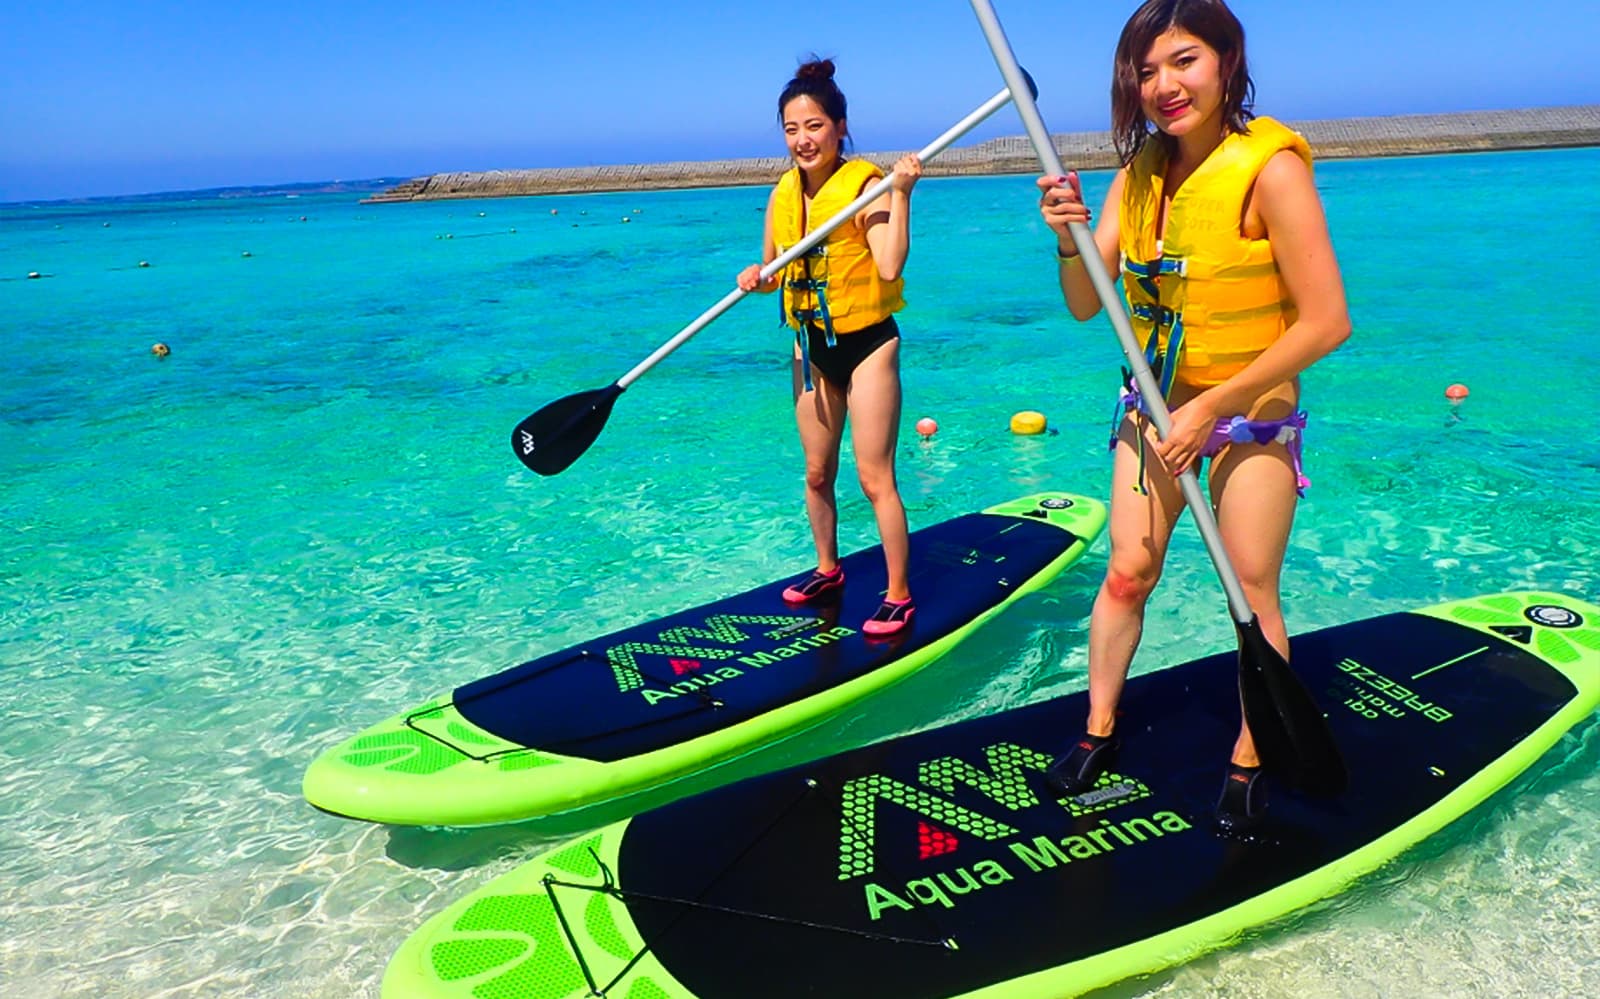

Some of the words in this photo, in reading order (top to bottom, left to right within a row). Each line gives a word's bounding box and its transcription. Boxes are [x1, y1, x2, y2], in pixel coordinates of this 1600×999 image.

[737, 625, 858, 669] Marina
[1335, 658, 1454, 723] BREEZE
[864, 858, 1014, 921] Aqua
[1008, 810, 1193, 873] Marina
